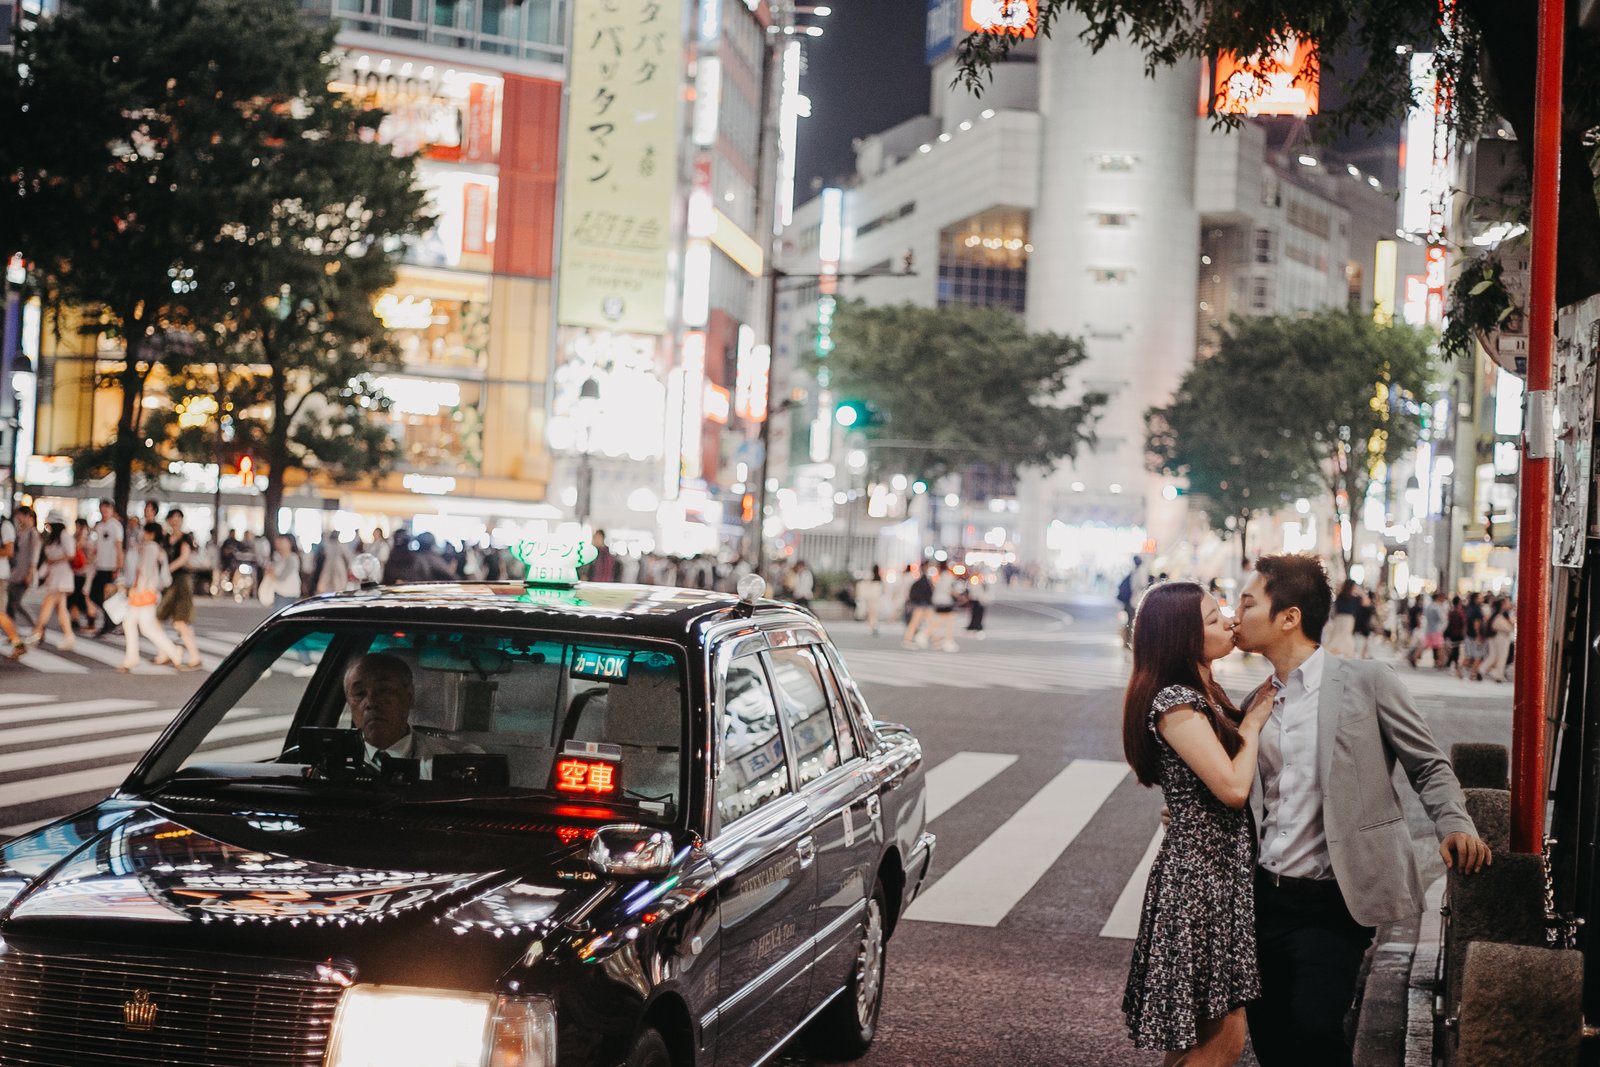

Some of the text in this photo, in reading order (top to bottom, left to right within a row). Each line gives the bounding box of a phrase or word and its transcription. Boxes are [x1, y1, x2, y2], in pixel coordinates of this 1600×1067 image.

[524, 541, 574, 557] グリーン
[535, 566, 562, 580] 1611
[574, 654, 626, 677] カードOK
[559, 760, 614, 791] 空車
